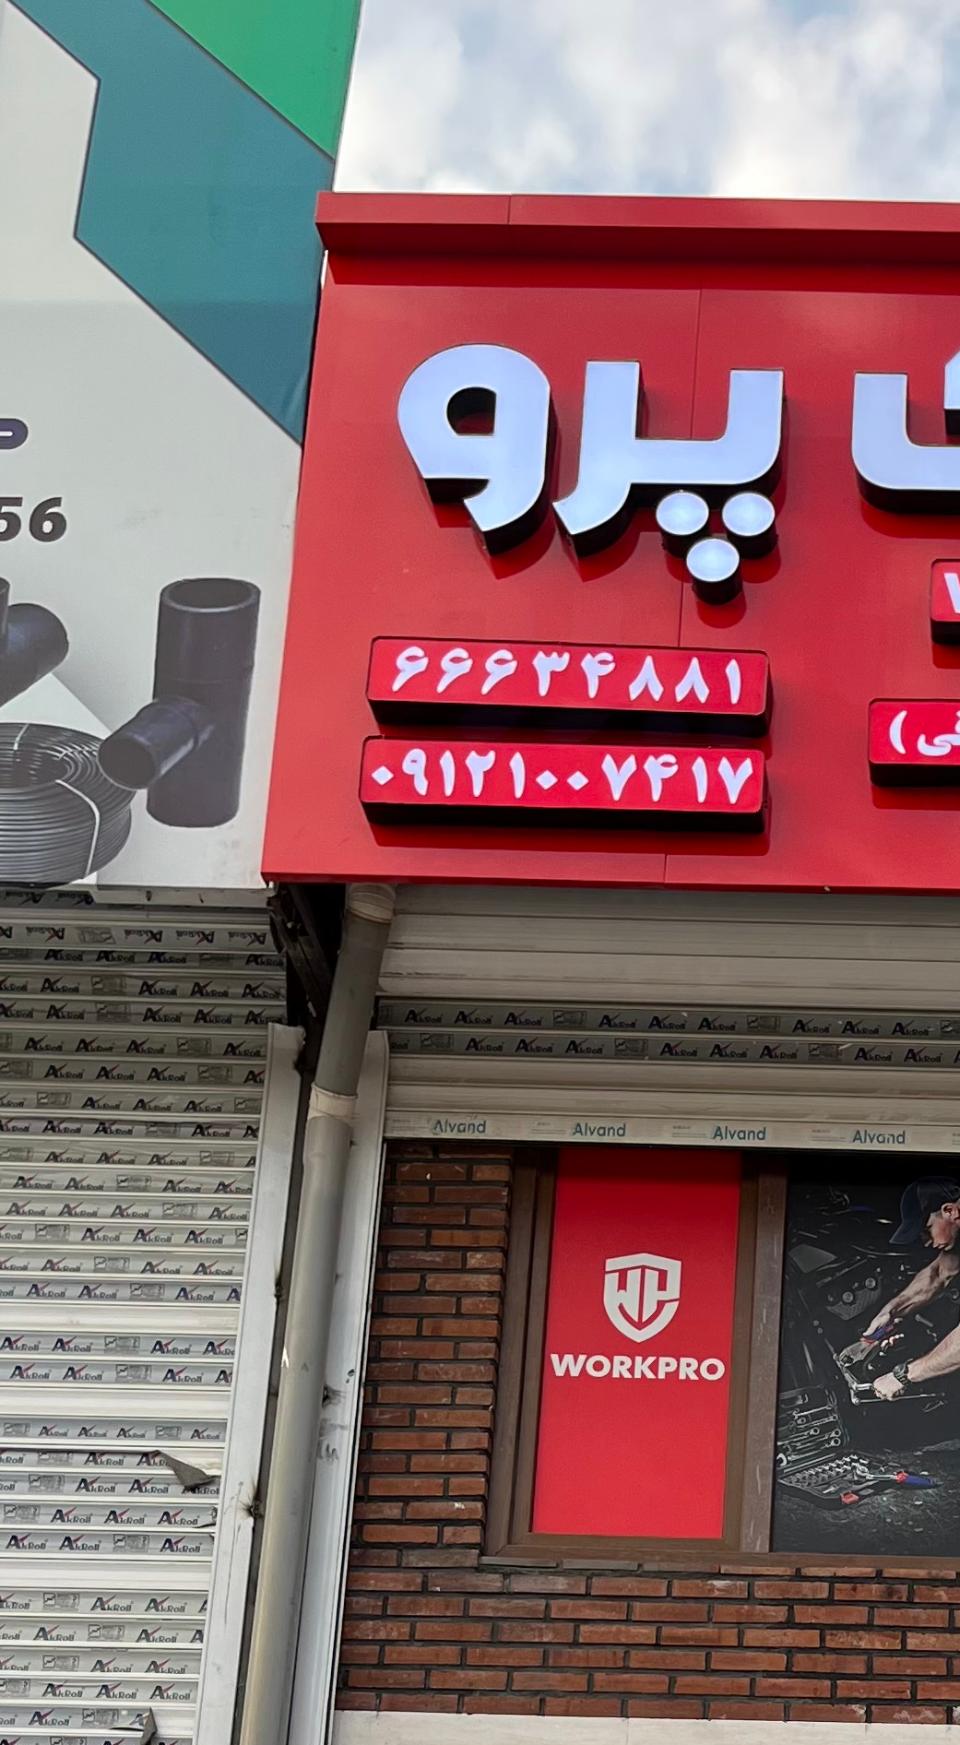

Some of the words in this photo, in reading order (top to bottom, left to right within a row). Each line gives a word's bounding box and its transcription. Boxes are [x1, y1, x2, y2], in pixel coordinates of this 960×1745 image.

[398, 343, 784, 582] پرو
[392, 646, 741, 704] ۶۶۶۳۴۸۸۱
[371, 748, 753, 804] ۰۹۱۲۱۰۰۷۴۱۷
[572, 1122, 627, 1138] Alvand
[711, 1125, 767, 1142] Alvand
[851, 1128, 906, 1145] Alvand
[551, 1353, 725, 1381] WORKPRO
